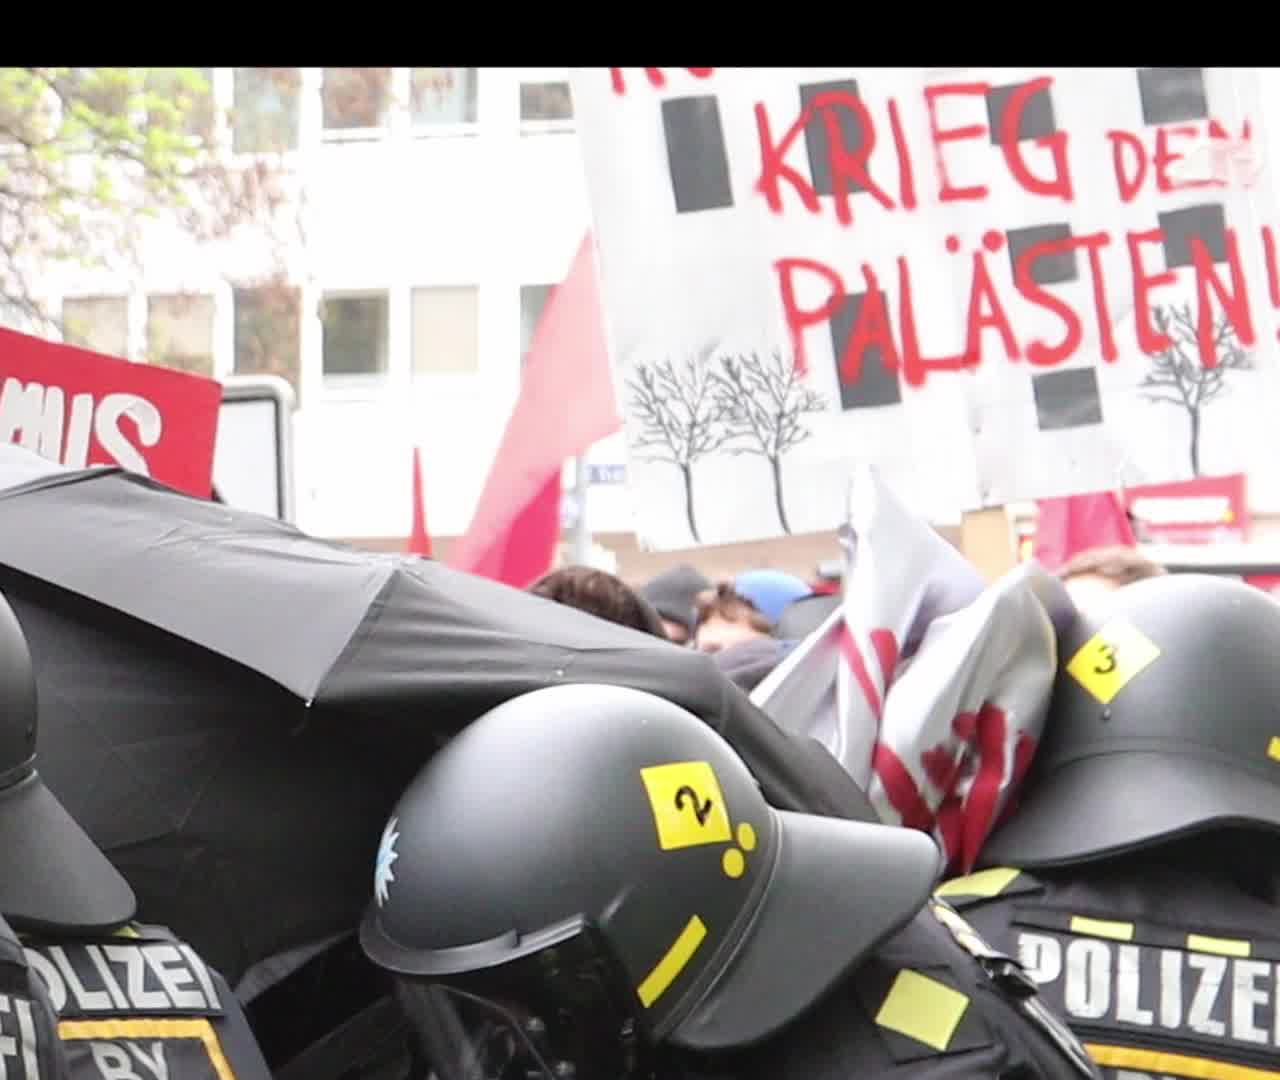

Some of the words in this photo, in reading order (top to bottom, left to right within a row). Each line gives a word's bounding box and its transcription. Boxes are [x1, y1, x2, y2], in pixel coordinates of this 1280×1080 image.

[753, 75, 1074, 225] KRIEG
[1093, 644, 1117, 675] 3
[674, 785, 712, 827] 2
[1017, 932, 1280, 1047] POLIZE
